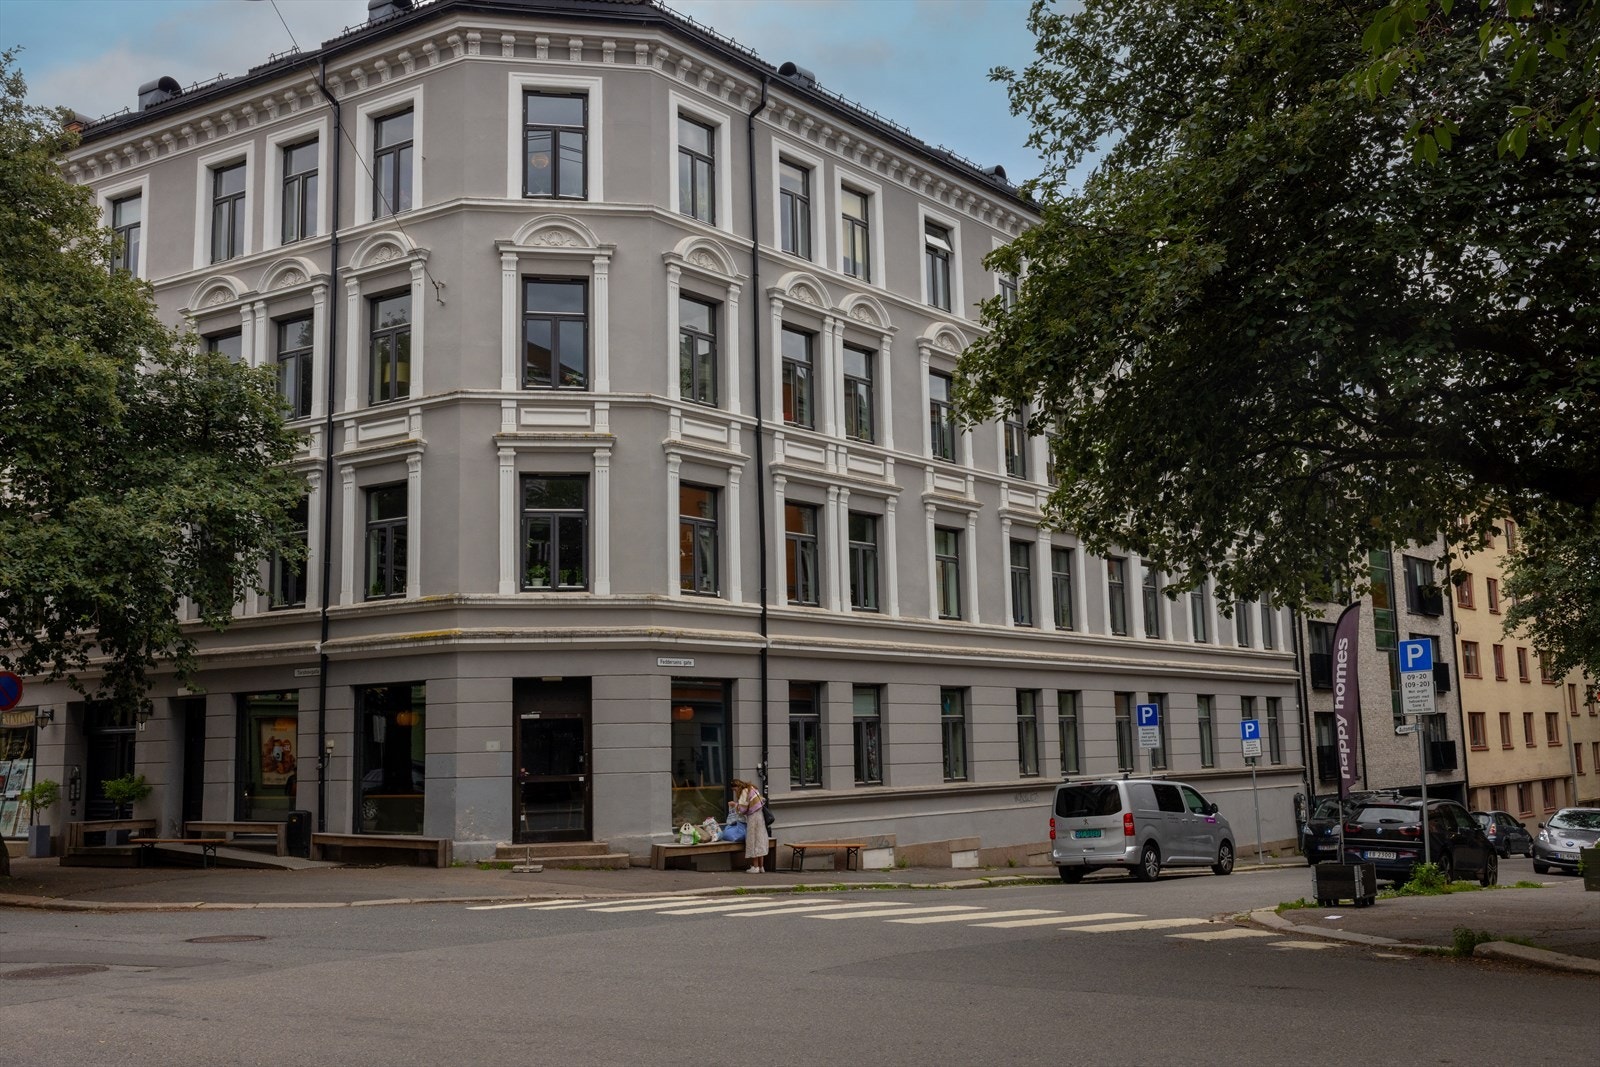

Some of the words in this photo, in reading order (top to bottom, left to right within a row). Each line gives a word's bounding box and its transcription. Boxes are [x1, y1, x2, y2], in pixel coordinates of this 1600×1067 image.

[1406, 644, 1424, 668] P
[1334, 638, 1348, 710] homes
[1142, 707, 1153, 724] P
[1245, 723, 1255, 738] P
